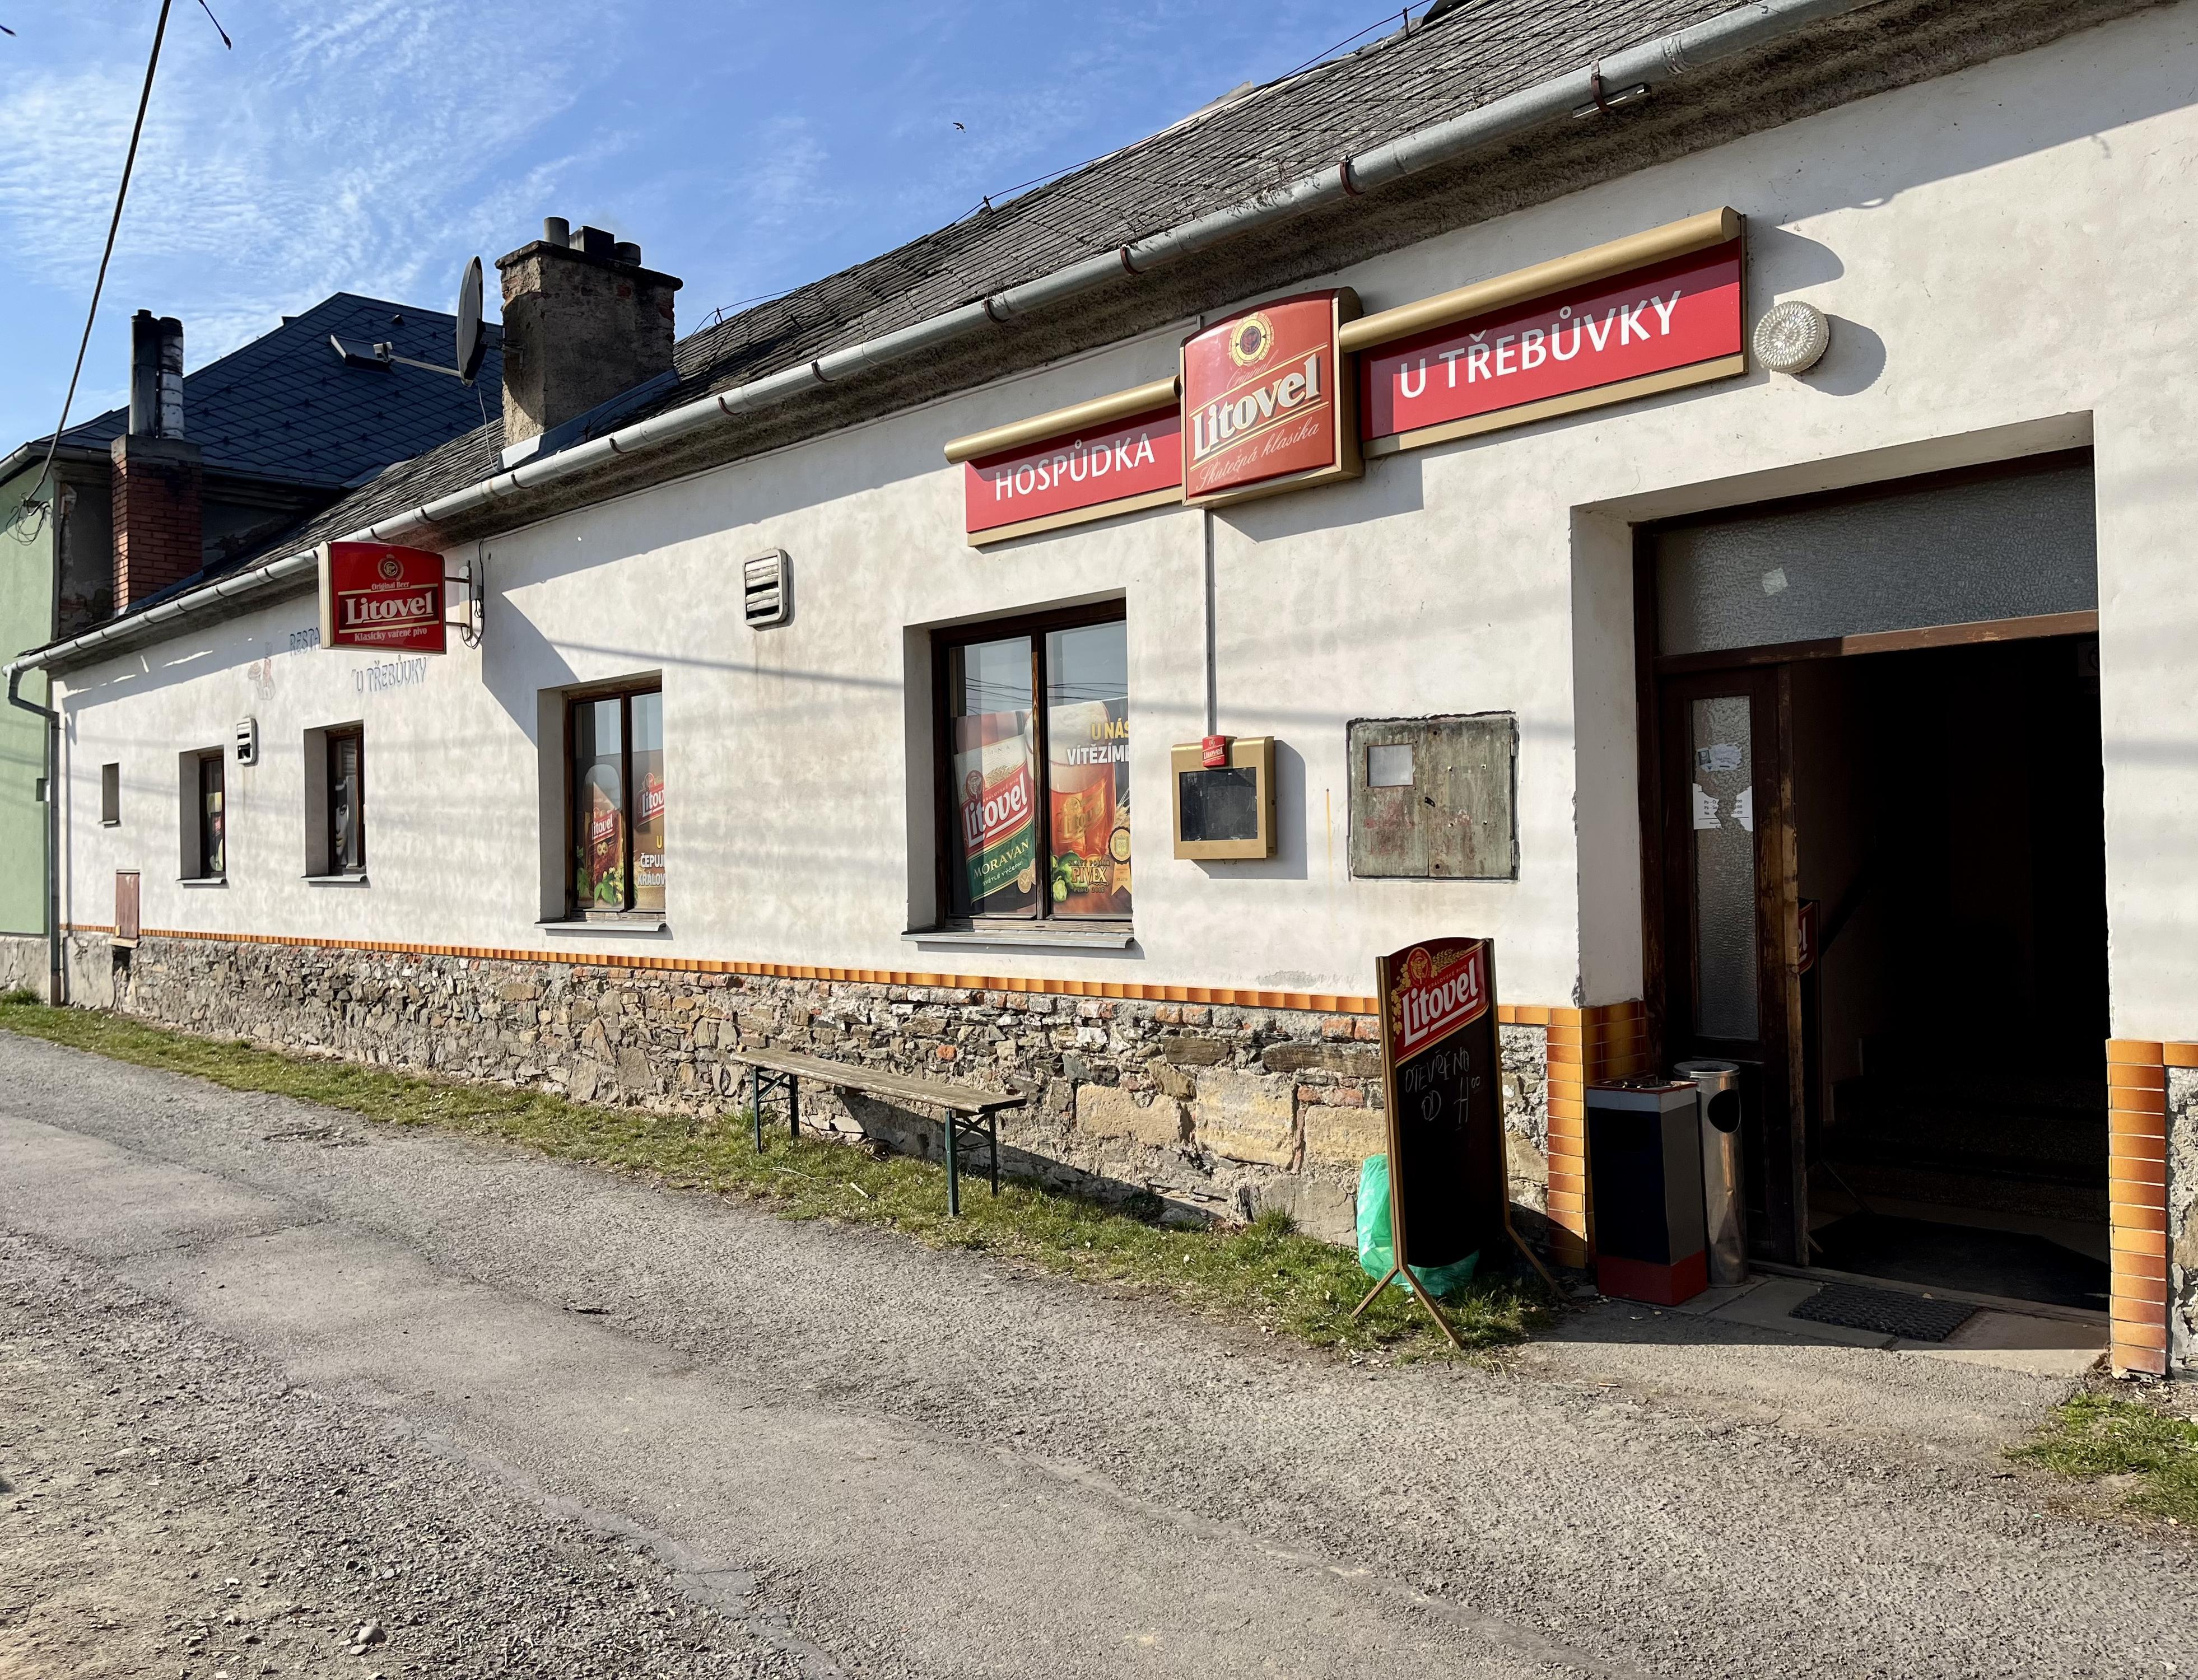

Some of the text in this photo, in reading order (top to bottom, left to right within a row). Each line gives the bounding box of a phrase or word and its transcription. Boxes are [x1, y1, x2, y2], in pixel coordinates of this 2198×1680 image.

[1401, 290, 1681, 398] U TŘEBŮVKY
[1227, 349, 1279, 390] Original
[1192, 353, 1321, 461] Litovel
[996, 433, 1155, 501] HOSPŮDKA
[1196, 417, 1319, 491] Skutečná klasika
[371, 582, 395, 591] Original
[346, 591, 434, 625] Litovel
[355, 632, 386, 642] Klasicky
[413, 627, 427, 637] pivo
[1092, 724, 1101, 740] U
[1204, 746, 1223, 760] Litovel
[965, 771, 1028, 848] Litovel
[592, 813, 613, 841] Litovel
[656, 836, 663, 849] U
[974, 839, 1029, 879] MORAVAN
[1072, 867, 1109, 885] PIVEX
[1402, 957, 1479, 1047] Litovel
[1422, 1090, 1442, 1121] OD
